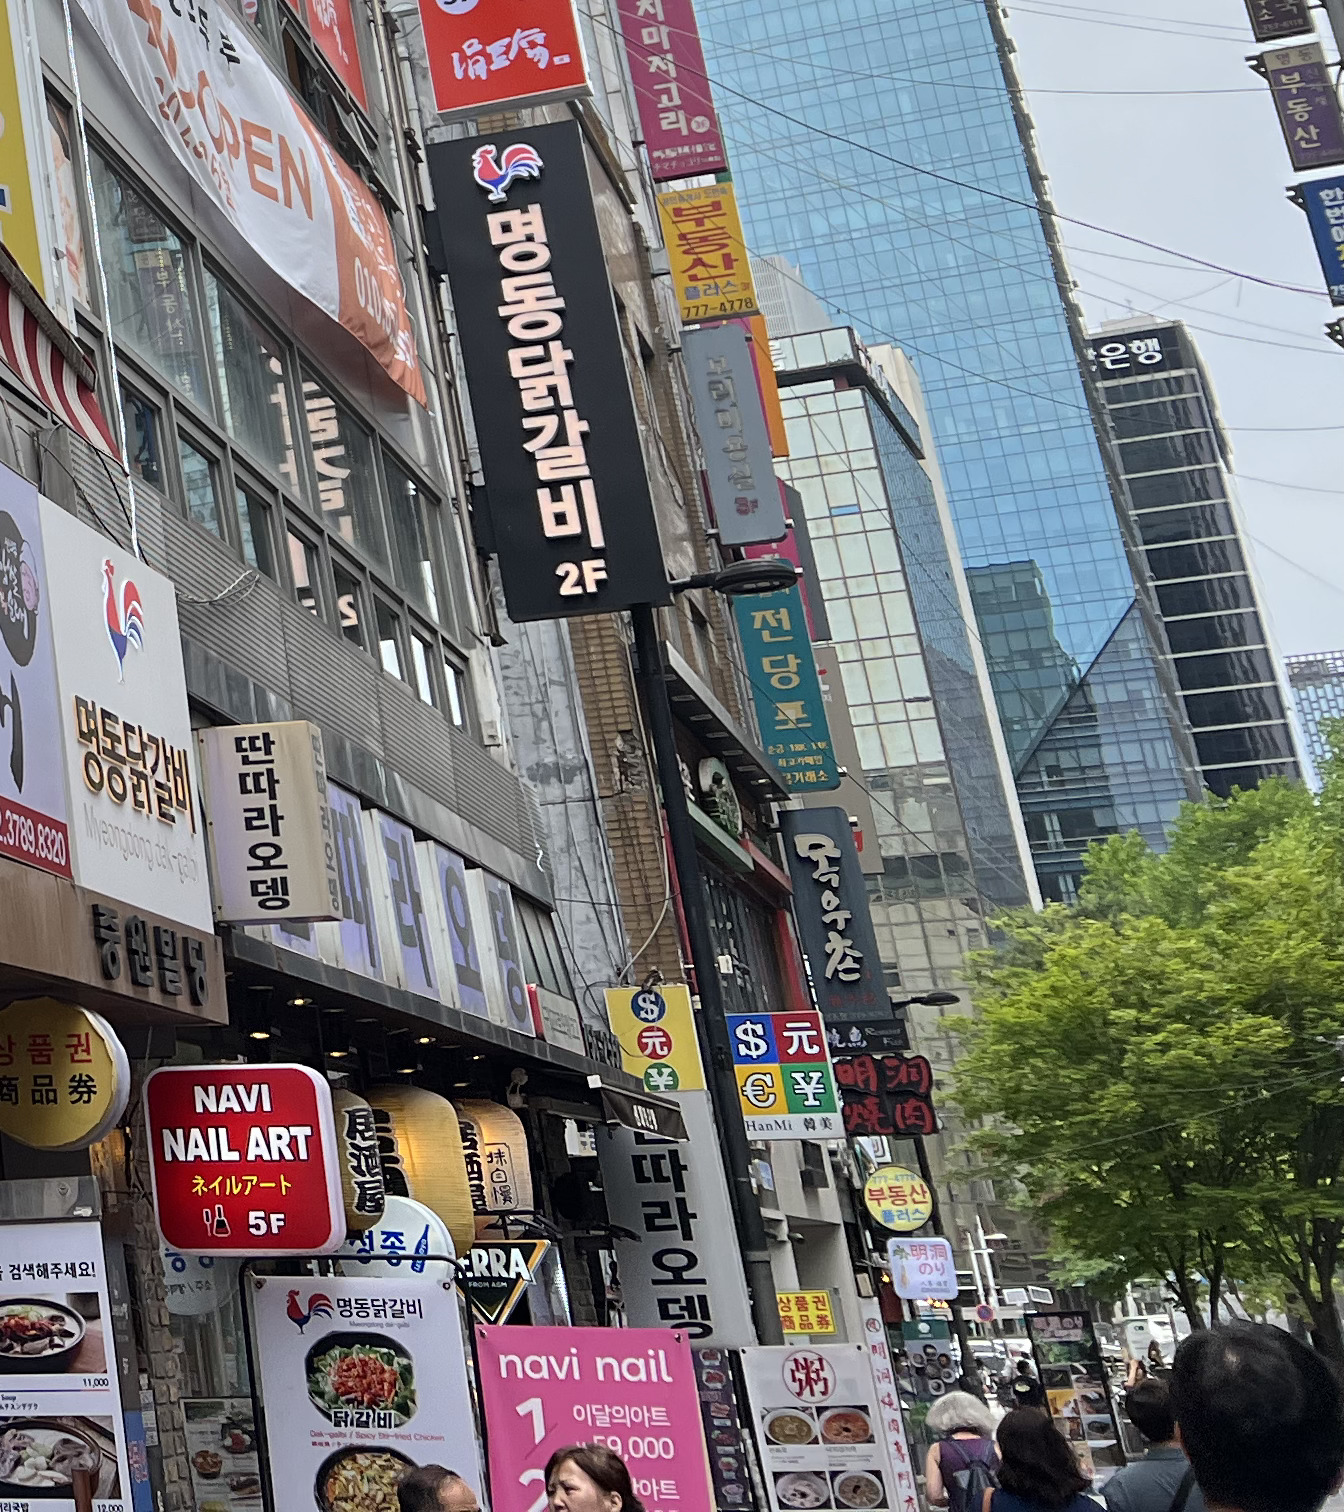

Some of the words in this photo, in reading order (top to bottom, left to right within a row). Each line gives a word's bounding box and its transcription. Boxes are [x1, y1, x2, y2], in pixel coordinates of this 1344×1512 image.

[1280, 71, 1322, 150] 부동산
[672, 199, 740, 283] 부동산
[683, 297, 753, 319] 777-4778
[1098, 338, 1163, 370] 은행
[486, 202, 607, 551] 명동닭갈비
[554, 558, 609, 597] 2F
[750, 607, 812, 731] 전당포
[74, 693, 197, 837] 명동닭갈비
[234, 732, 291, 912] 딴따라오뎅
[278, 800, 527, 1025] 따라오뎅
[793, 833, 864, 982] 목우촌
[636, 992, 660, 1021] $
[641, 1031, 669, 1057] 元
[734, 1020, 769, 1060] $
[782, 1021, 821, 1056] 元
[834, 1054, 930, 1093] 明洞
[193, 1083, 273, 1114] NAVI
[742, 1072, 777, 1109] €
[790, 1071, 826, 1107] ¥
[745, 1118, 793, 1133] HanMi
[162, 1126, 241, 1163] NAIL
[246, 1125, 313, 1163] ART
[191, 1174, 292, 1197] ネイルアート
[867, 1184, 929, 1208] 부동산
[247, 1210, 287, 1237] 5F
[881, 1208, 927, 1223] 플러스
[458, 1247, 536, 1285] RRA
[909, 1244, 948, 1261] 明洞
[8, 1261, 97, 1282] 검색해주세요!
[918, 1262, 946, 1276] のり
[336, 1297, 424, 1320] 명동닭갈비
[778, 1295, 827, 1313] 상품권
[781, 1314, 832, 1332] 商品券
[499, 1347, 581, 1381] navi
[595, 1349, 674, 1383] nail
[82, 1377, 110, 1389] 11,000
[333, 1409, 394, 1430] 닭갈비
[515, 1396, 547, 1446] 1
[572, 1404, 671, 1428] 이달의아트
[632, 1476, 681, 1501] 아트
